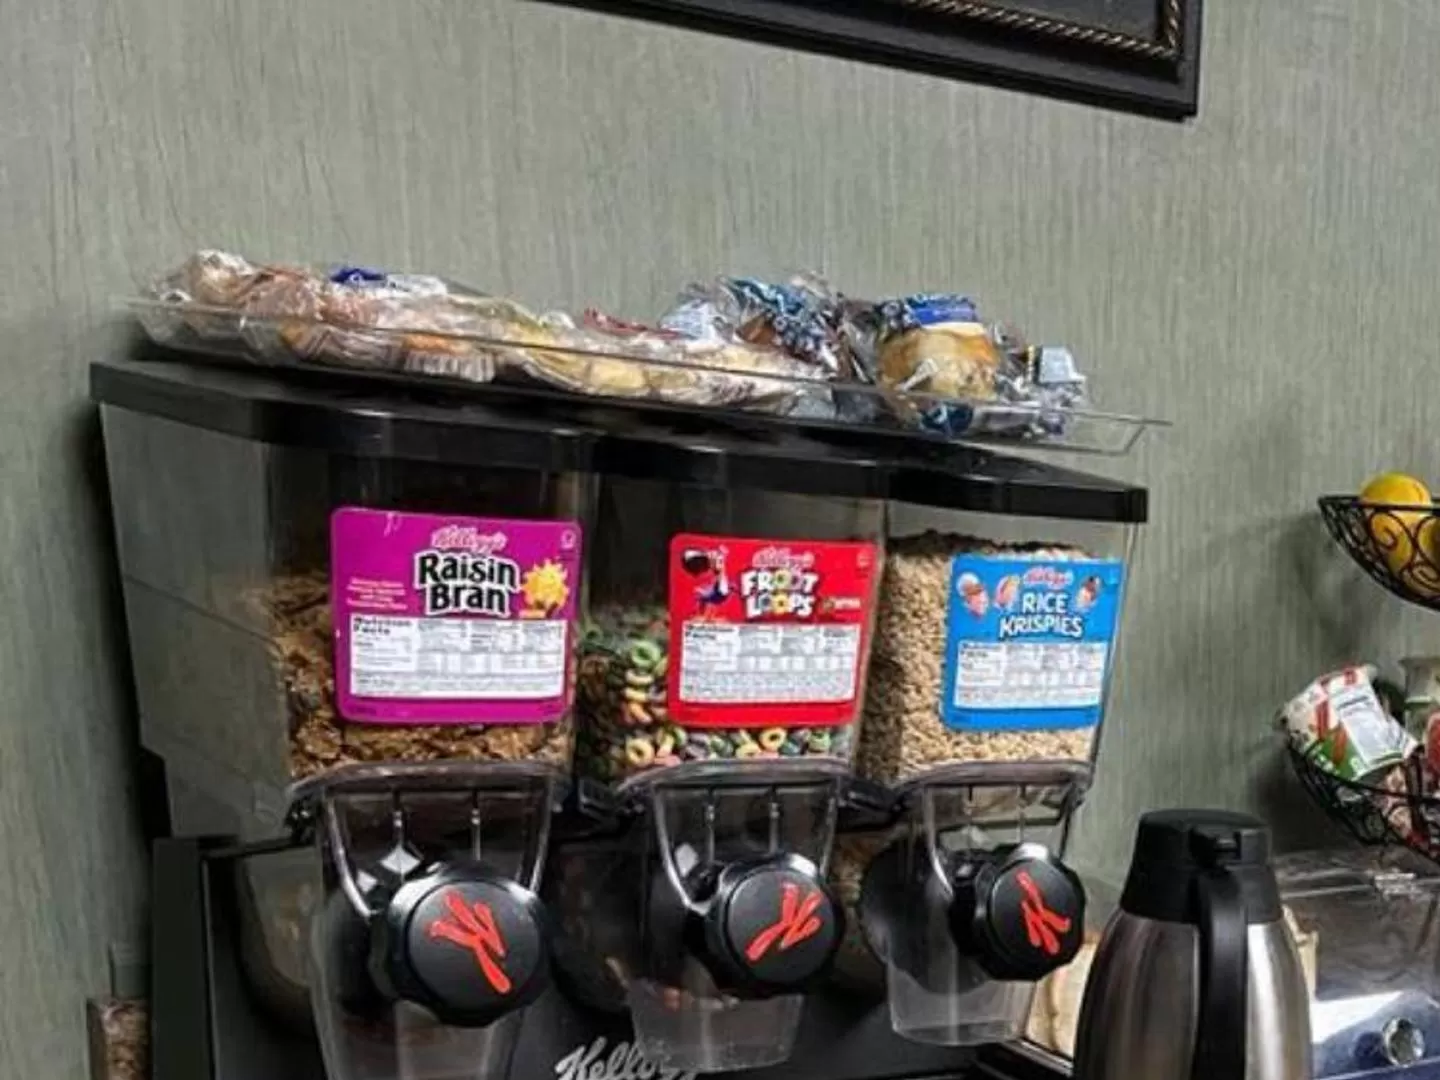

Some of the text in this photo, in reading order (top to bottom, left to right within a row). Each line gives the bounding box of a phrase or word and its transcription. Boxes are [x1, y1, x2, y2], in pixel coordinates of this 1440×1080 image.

[416, 550, 520, 589] Raisin
[740, 567, 819, 597] FROOT
[426, 581, 510, 616] Bran
[746, 593, 816, 618] LOOPS
[1021, 591, 1069, 614] RICE
[999, 614, 1083, 639] KRISPIES
